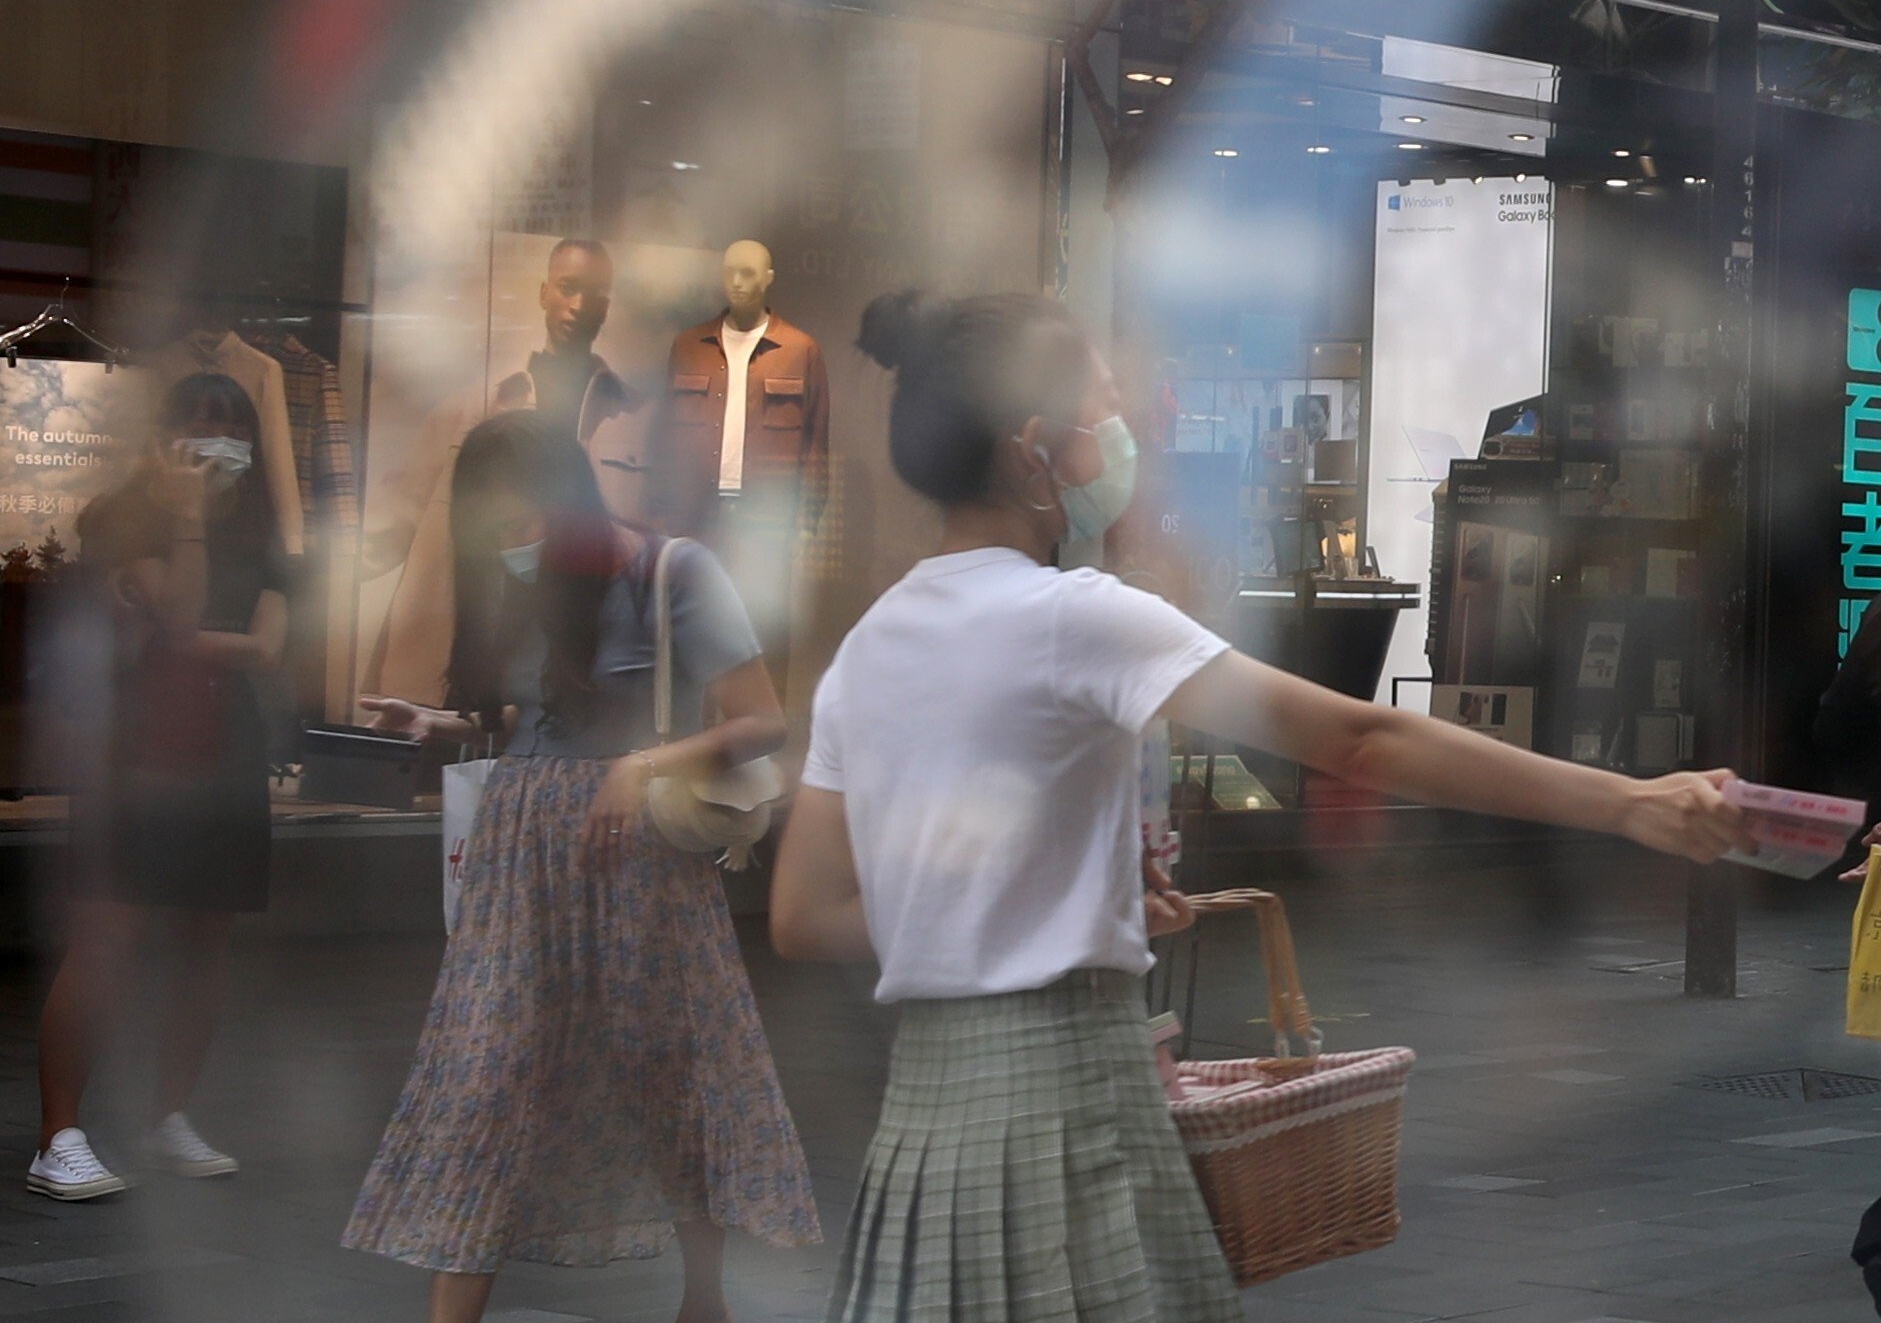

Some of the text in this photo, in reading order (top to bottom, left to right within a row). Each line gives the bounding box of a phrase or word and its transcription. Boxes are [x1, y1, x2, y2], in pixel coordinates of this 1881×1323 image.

[1403, 196, 1455, 208] Windows 10
[1498, 210, 1535, 223] Galaxy
[4, 425, 39, 443] The
[14, 451, 102, 467] essentials
